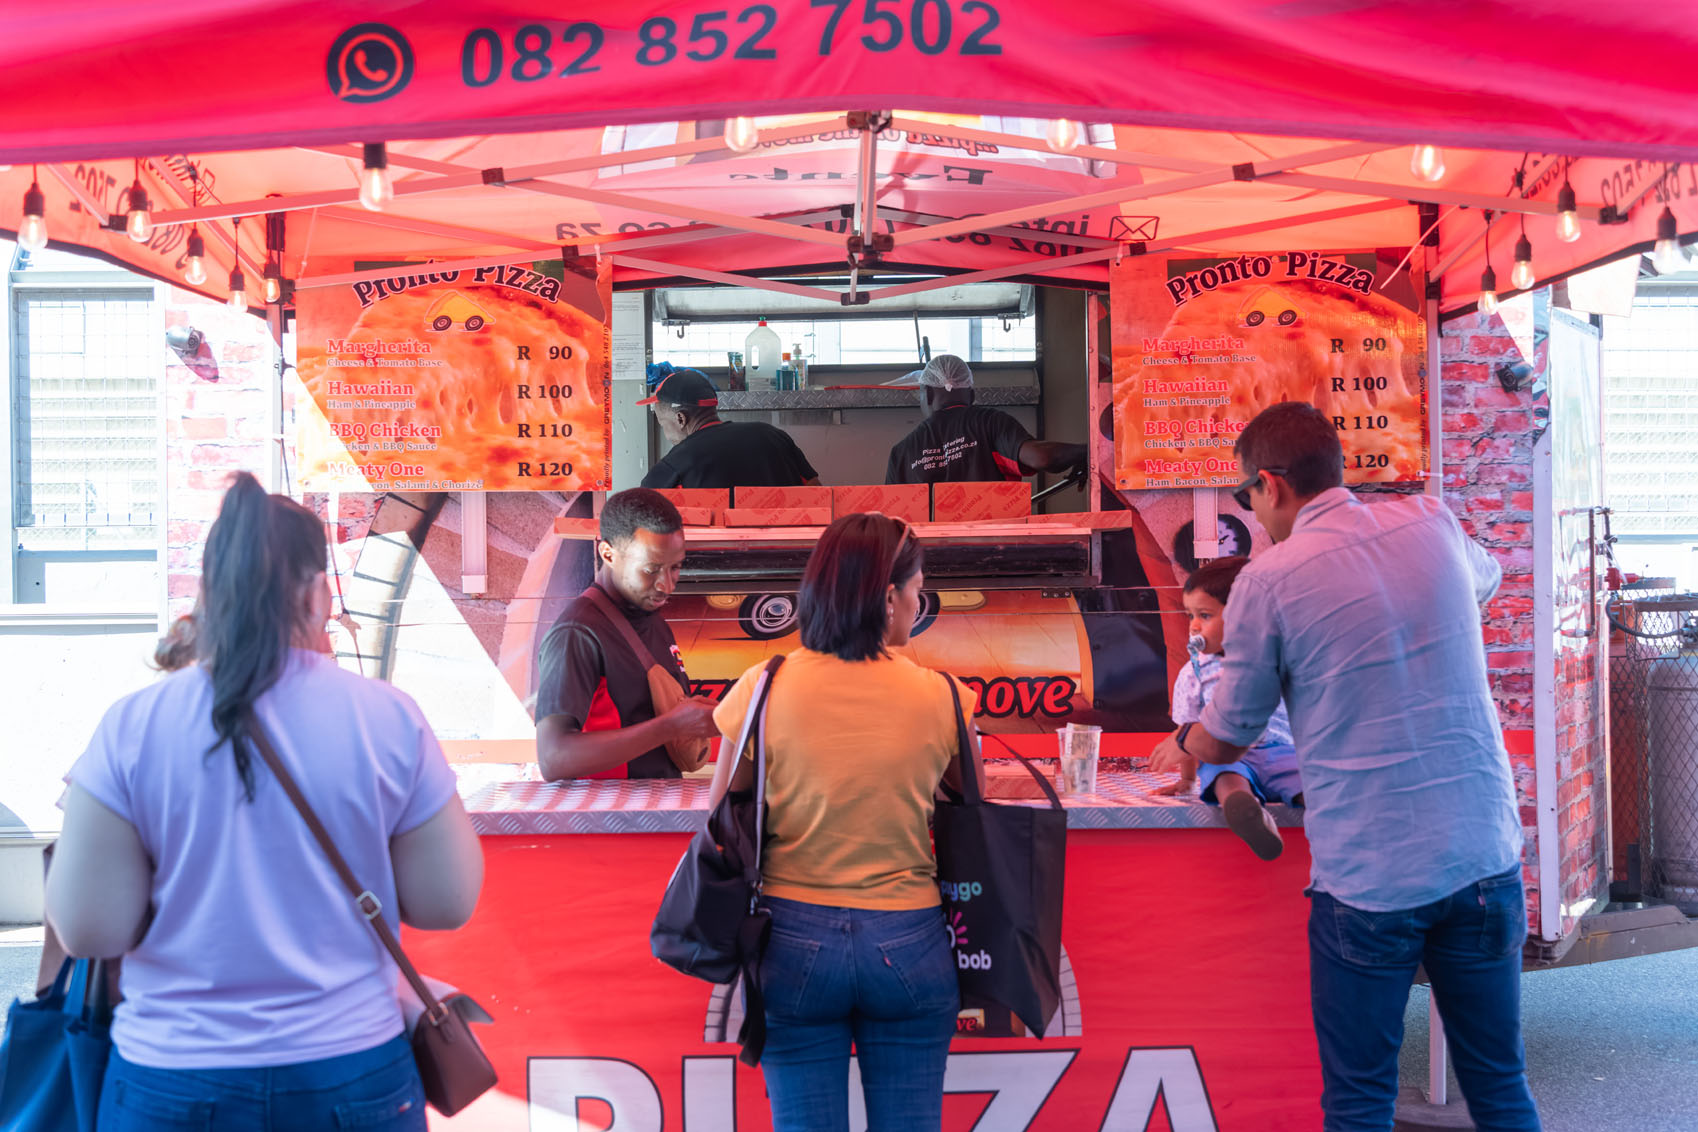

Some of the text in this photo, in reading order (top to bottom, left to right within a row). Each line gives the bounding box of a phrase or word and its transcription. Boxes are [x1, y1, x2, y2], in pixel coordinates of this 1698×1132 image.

[461, 0, 1003, 89] 082 852 7502
[472, 265, 562, 303] Pizza
[1166, 251, 1375, 306] Pronto Pizza
[327, 338, 431, 357] Margherita
[516, 345, 573, 361] R 90
[1142, 335, 1245, 355] Margherita
[1330, 337, 1387, 353] R 90
[376, 358, 417, 367] Tomato
[1142, 356, 1179, 366] Cheese
[1181, 355, 1189, 364] &
[1190, 354, 1230, 364] Tomato
[327, 380, 415, 396] Hawaiian
[517, 384, 573, 399] R 100
[1143, 377, 1229, 394] Hawaiian
[1331, 376, 1388, 392] R 100
[327, 399, 416, 411] Ham & Pineapple
[1143, 396, 1231, 408] Ham & Pineapple
[517, 423, 573, 438] R 110
[1144, 420, 1182, 438] BBQ
[1332, 415, 1389, 431] R 110
[330, 422, 442, 441] BBQ Chicken
[373, 442, 380, 451] &
[382, 442, 405, 452] BBQ
[406, 442, 437, 451] Sauce
[1144, 440, 1187, 449] Chicken
[1188, 439, 1196, 448] &
[1198, 438, 1220, 449] BBQ
[517, 462, 574, 477] R 120
[1145, 457, 1239, 476] Meaty One
[1354, 454, 1389, 469] 120
[328, 462, 425, 480] Meaty One
[394, 480, 430, 490] Salami
[431, 480, 438, 490] &
[957, 949, 992, 970] bob
